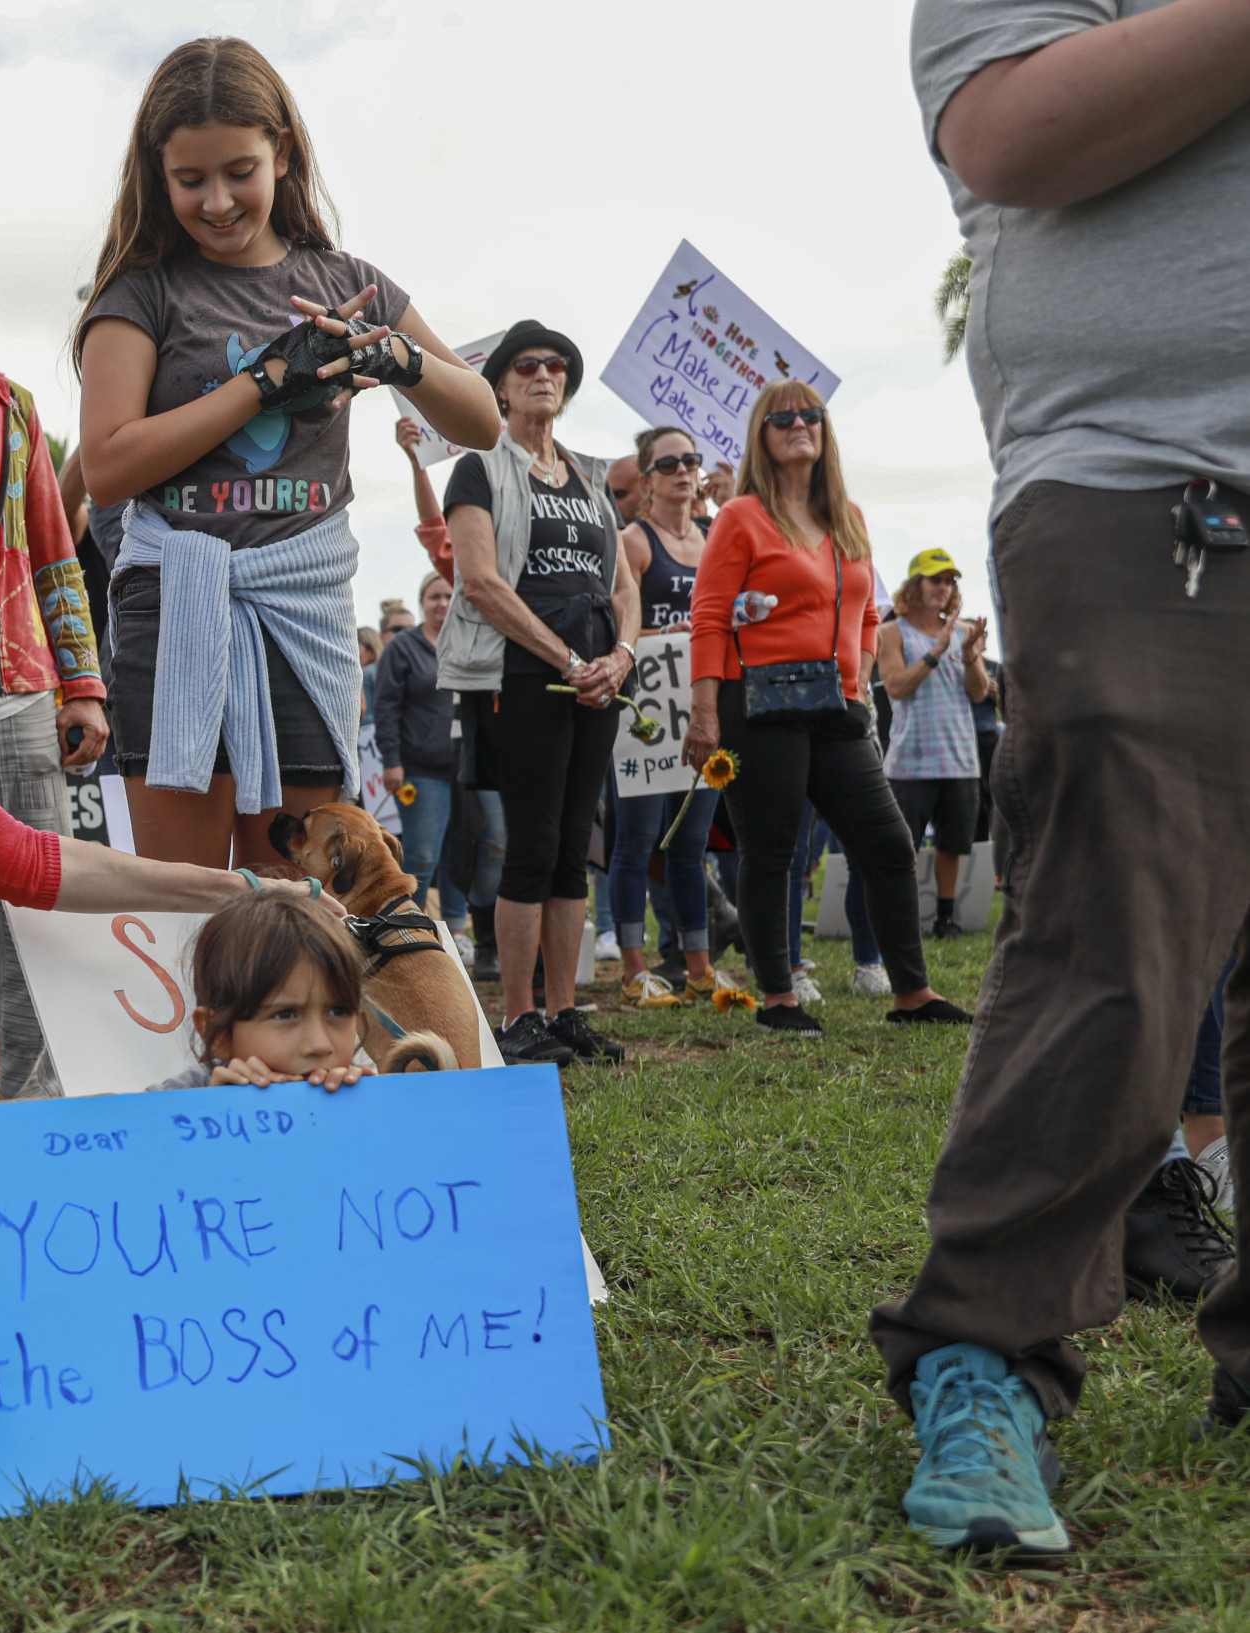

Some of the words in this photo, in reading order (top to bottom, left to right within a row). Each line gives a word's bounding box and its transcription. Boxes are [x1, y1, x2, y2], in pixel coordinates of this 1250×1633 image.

[659, 332, 720, 396] Make
[702, 413, 745, 459] Sens
[164, 485, 198, 513] BE
[530, 491, 604, 529] VERYONE
[566, 523, 579, 544] IS
[43, 1129, 128, 1156] Dear
[338, 1180, 481, 1252] NOT
[132, 1307, 297, 1391] BOSS
[332, 1304, 380, 1370] of
[420, 1286, 547, 1359] ME!
